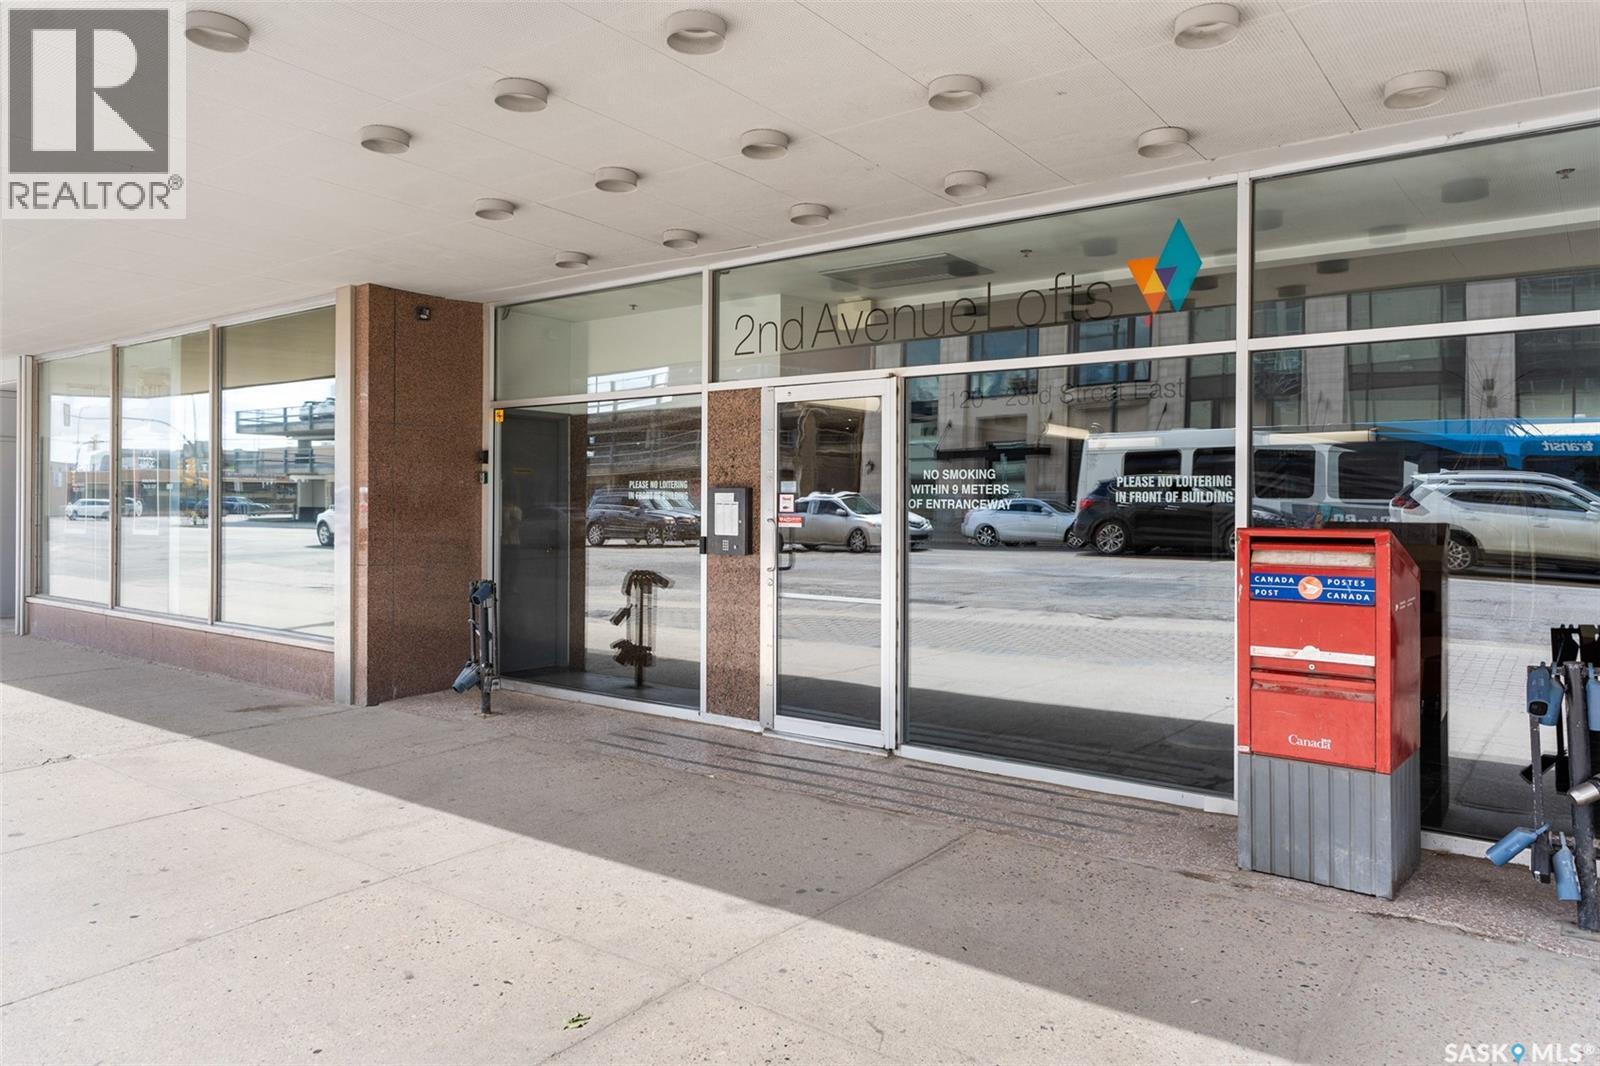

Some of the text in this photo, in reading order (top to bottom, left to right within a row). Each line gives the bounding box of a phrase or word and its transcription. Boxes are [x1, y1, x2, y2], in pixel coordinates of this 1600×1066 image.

[1134, 377, 1185, 401] East
[923, 469, 996, 480] NO SMOKING
[629, 480, 688, 489] PLEASE NO LOITERING
[1117, 475, 1233, 488] PLEASE NO LOITERING
[911, 484, 1009, 495] WITHIN 9 METERS
[1115, 490, 1234, 503] IN FRONT OF BUILDING
[908, 499, 1012, 510] OF ENTRANCEWAY
[1254, 575, 1366, 587] CANADA POSTES
[1255, 589, 1370, 601] POST CANADA
[1288, 733, 1332, 750] Canada
